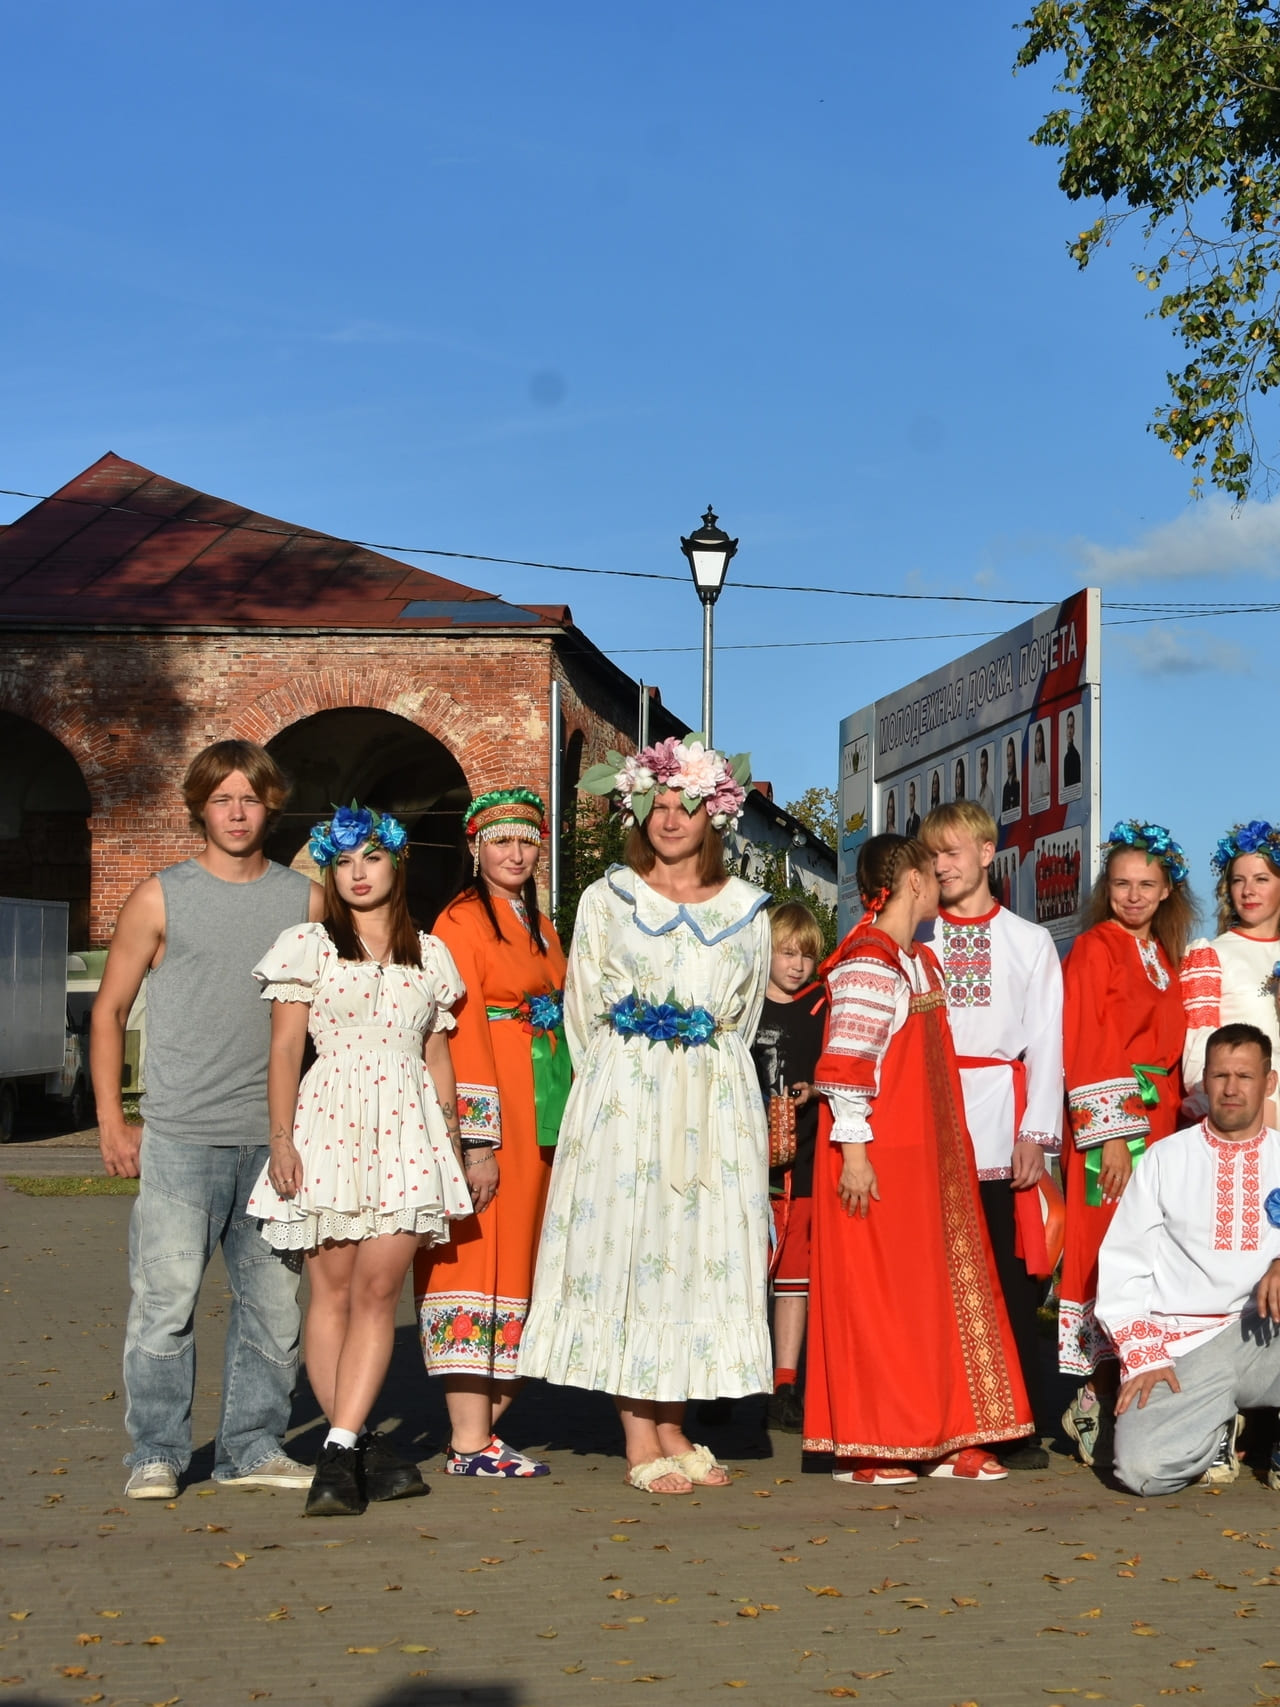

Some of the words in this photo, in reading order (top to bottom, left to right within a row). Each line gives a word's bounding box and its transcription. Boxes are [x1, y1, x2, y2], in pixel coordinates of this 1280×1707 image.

[880, 678, 964, 755] МОЛОДЕЖНАЯ
[966, 652, 1013, 720] ДОСКА
[1018, 621, 1078, 687] ПОЧЕТА
